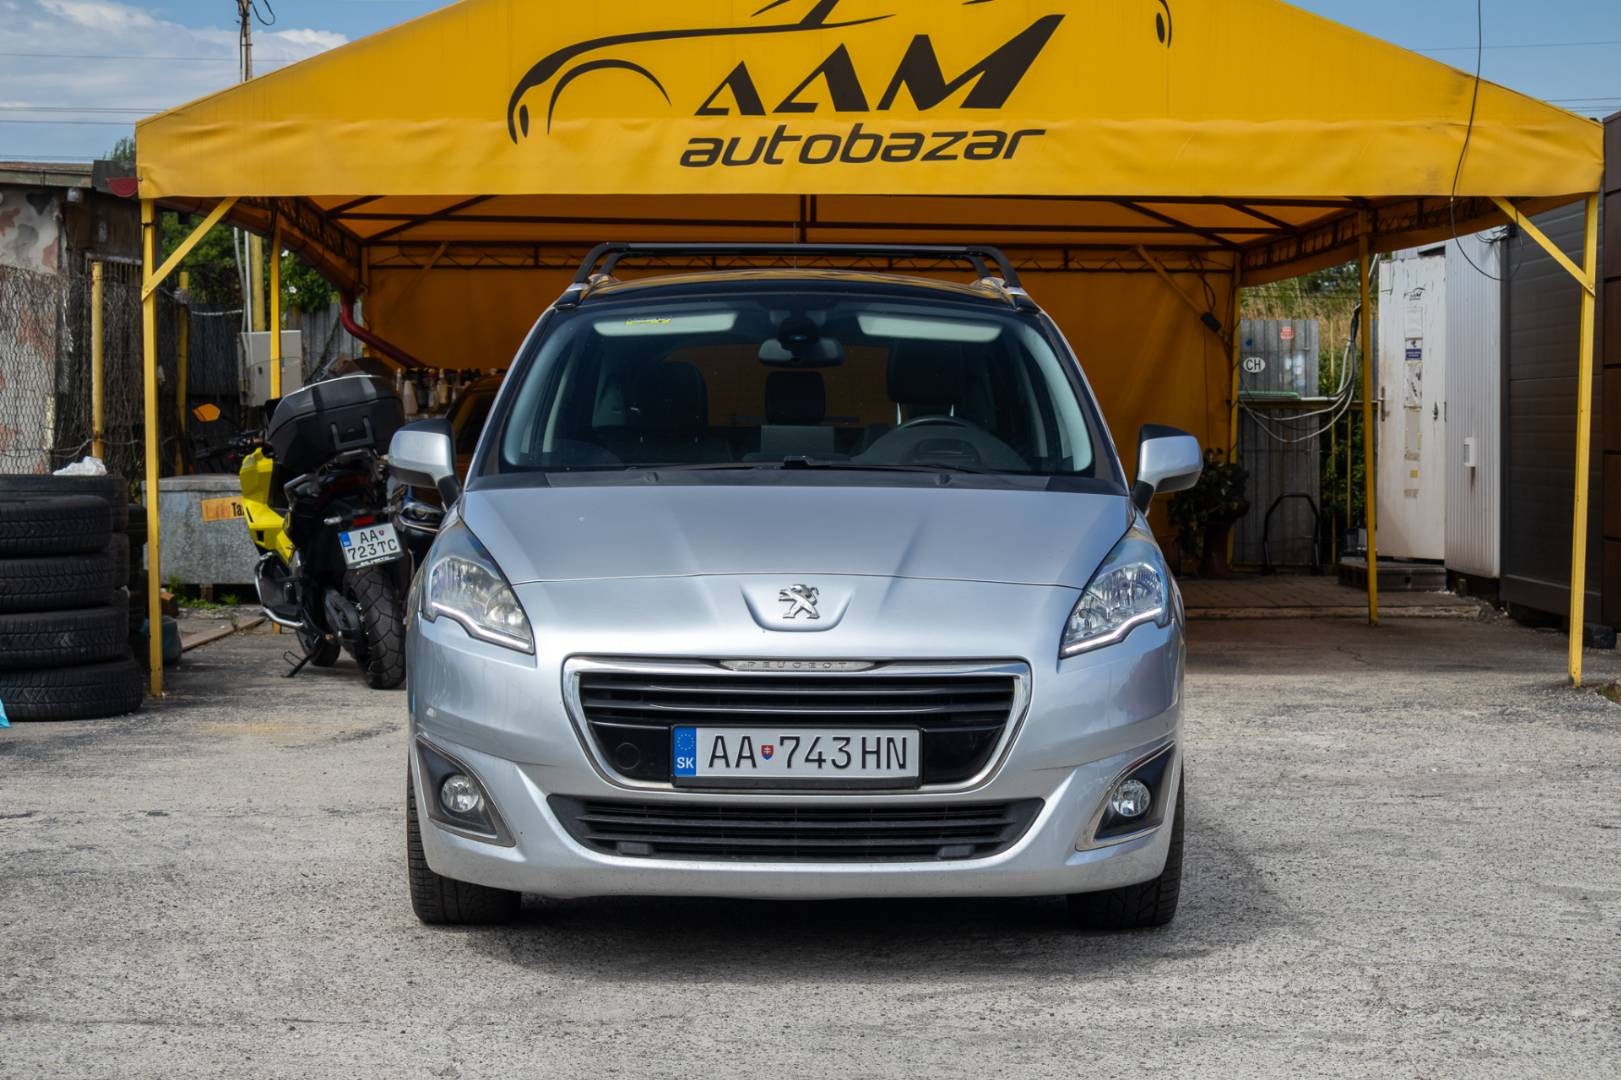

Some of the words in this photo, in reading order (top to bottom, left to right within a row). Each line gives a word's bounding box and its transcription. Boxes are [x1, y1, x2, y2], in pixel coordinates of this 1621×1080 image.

[694, 14, 1066, 116] AAM
[679, 122, 1046, 168] autobazar
[1246, 359, 1261, 371] CH
[231, 502, 244, 517] Ta
[360, 529, 379, 544] AA
[348, 538, 397, 560] 723TC
[677, 757, 694, 769] SK
[708, 735, 757, 769] AA
